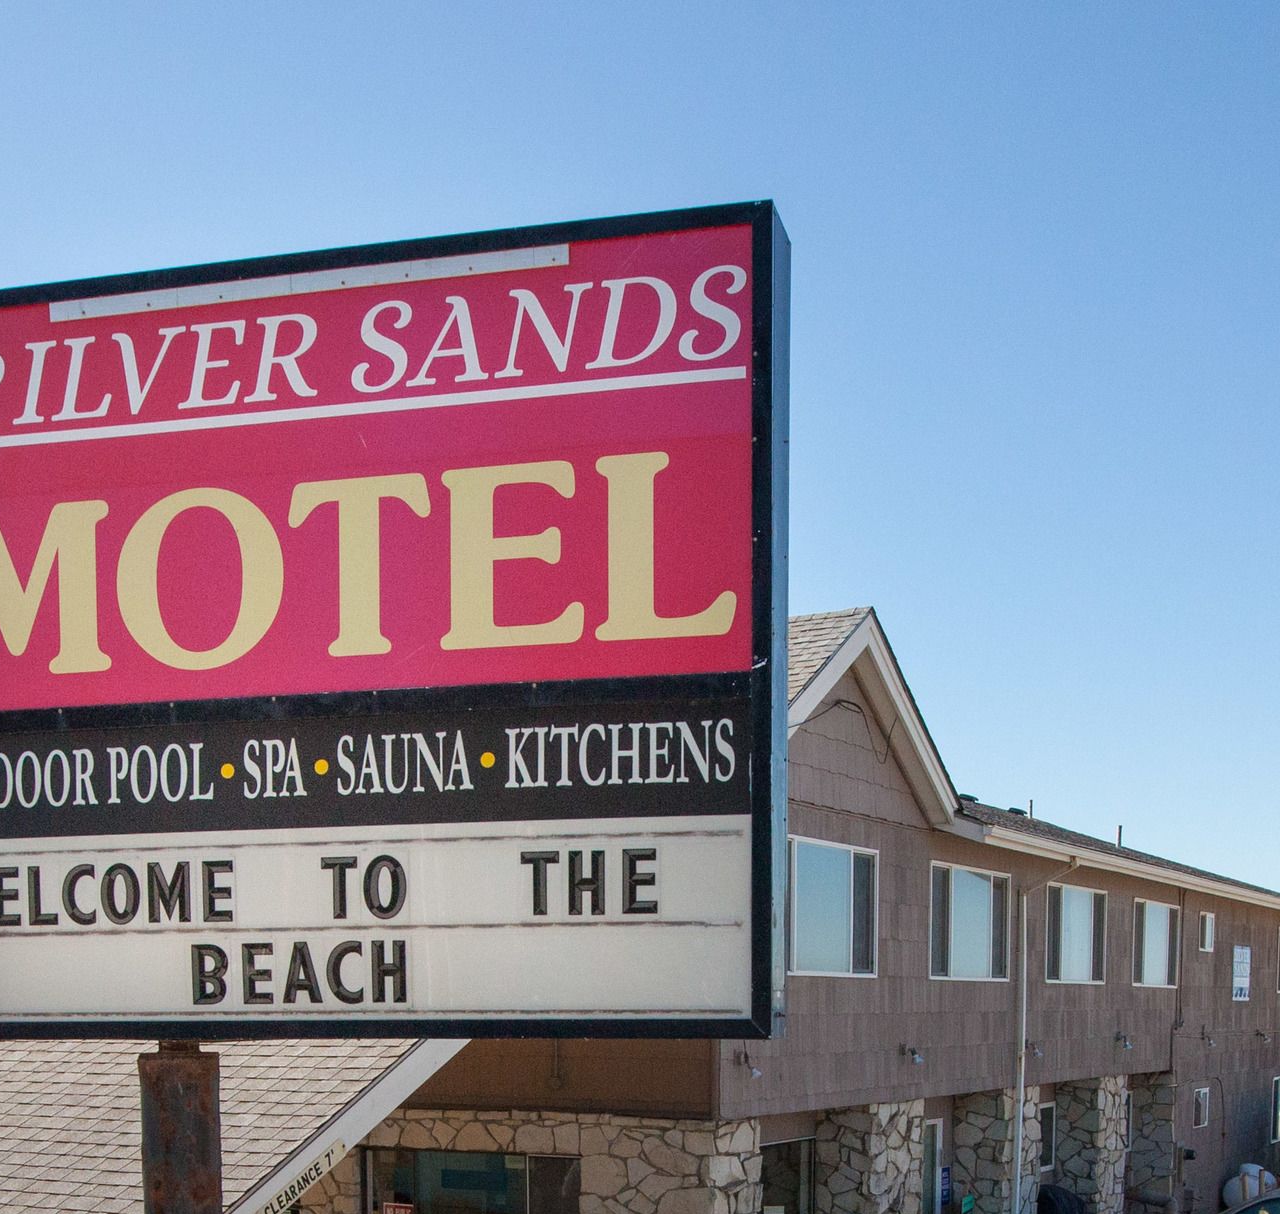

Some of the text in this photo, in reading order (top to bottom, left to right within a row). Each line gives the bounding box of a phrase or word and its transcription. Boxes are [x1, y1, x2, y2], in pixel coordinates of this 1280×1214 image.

[350, 264, 748, 393] SANDS
[106, 742, 214, 804] POOL
[243, 737, 308, 800] SPA
[336, 729, 475, 796] SAUNA
[504, 718, 736, 788] KITCHENS
[320, 854, 407, 920] TO
[520, 847, 660, 916] THE
[190, 939, 408, 1006] BEACH
